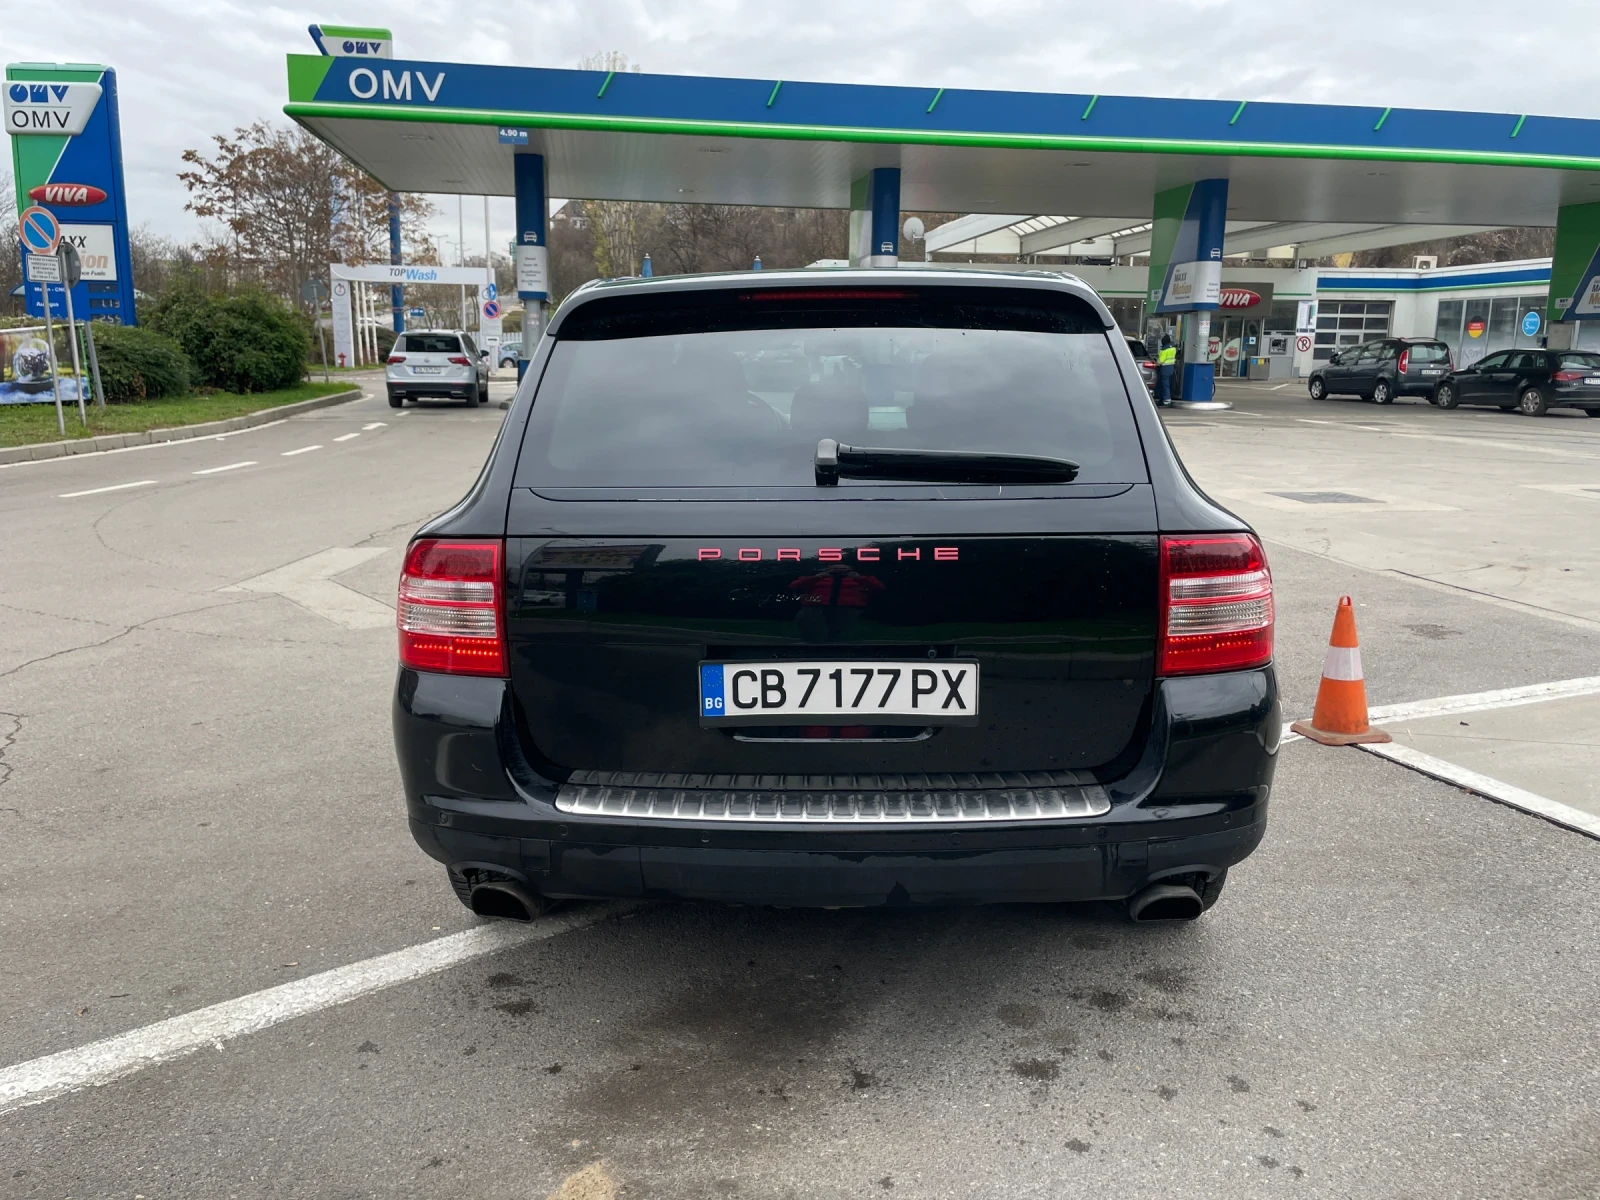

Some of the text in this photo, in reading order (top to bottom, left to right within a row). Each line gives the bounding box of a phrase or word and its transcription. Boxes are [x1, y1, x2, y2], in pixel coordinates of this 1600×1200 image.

[349, 68, 446, 102] OMV
[12, 110, 70, 128] OMV
[500, 129, 518, 137] 4.90
[45, 186, 88, 203] VIVA
[60, 235, 87, 248] AXX
[1219, 293, 1250, 306] VIVA
[698, 547, 958, 561] PORSCHE
[705, 697, 723, 709] BG
